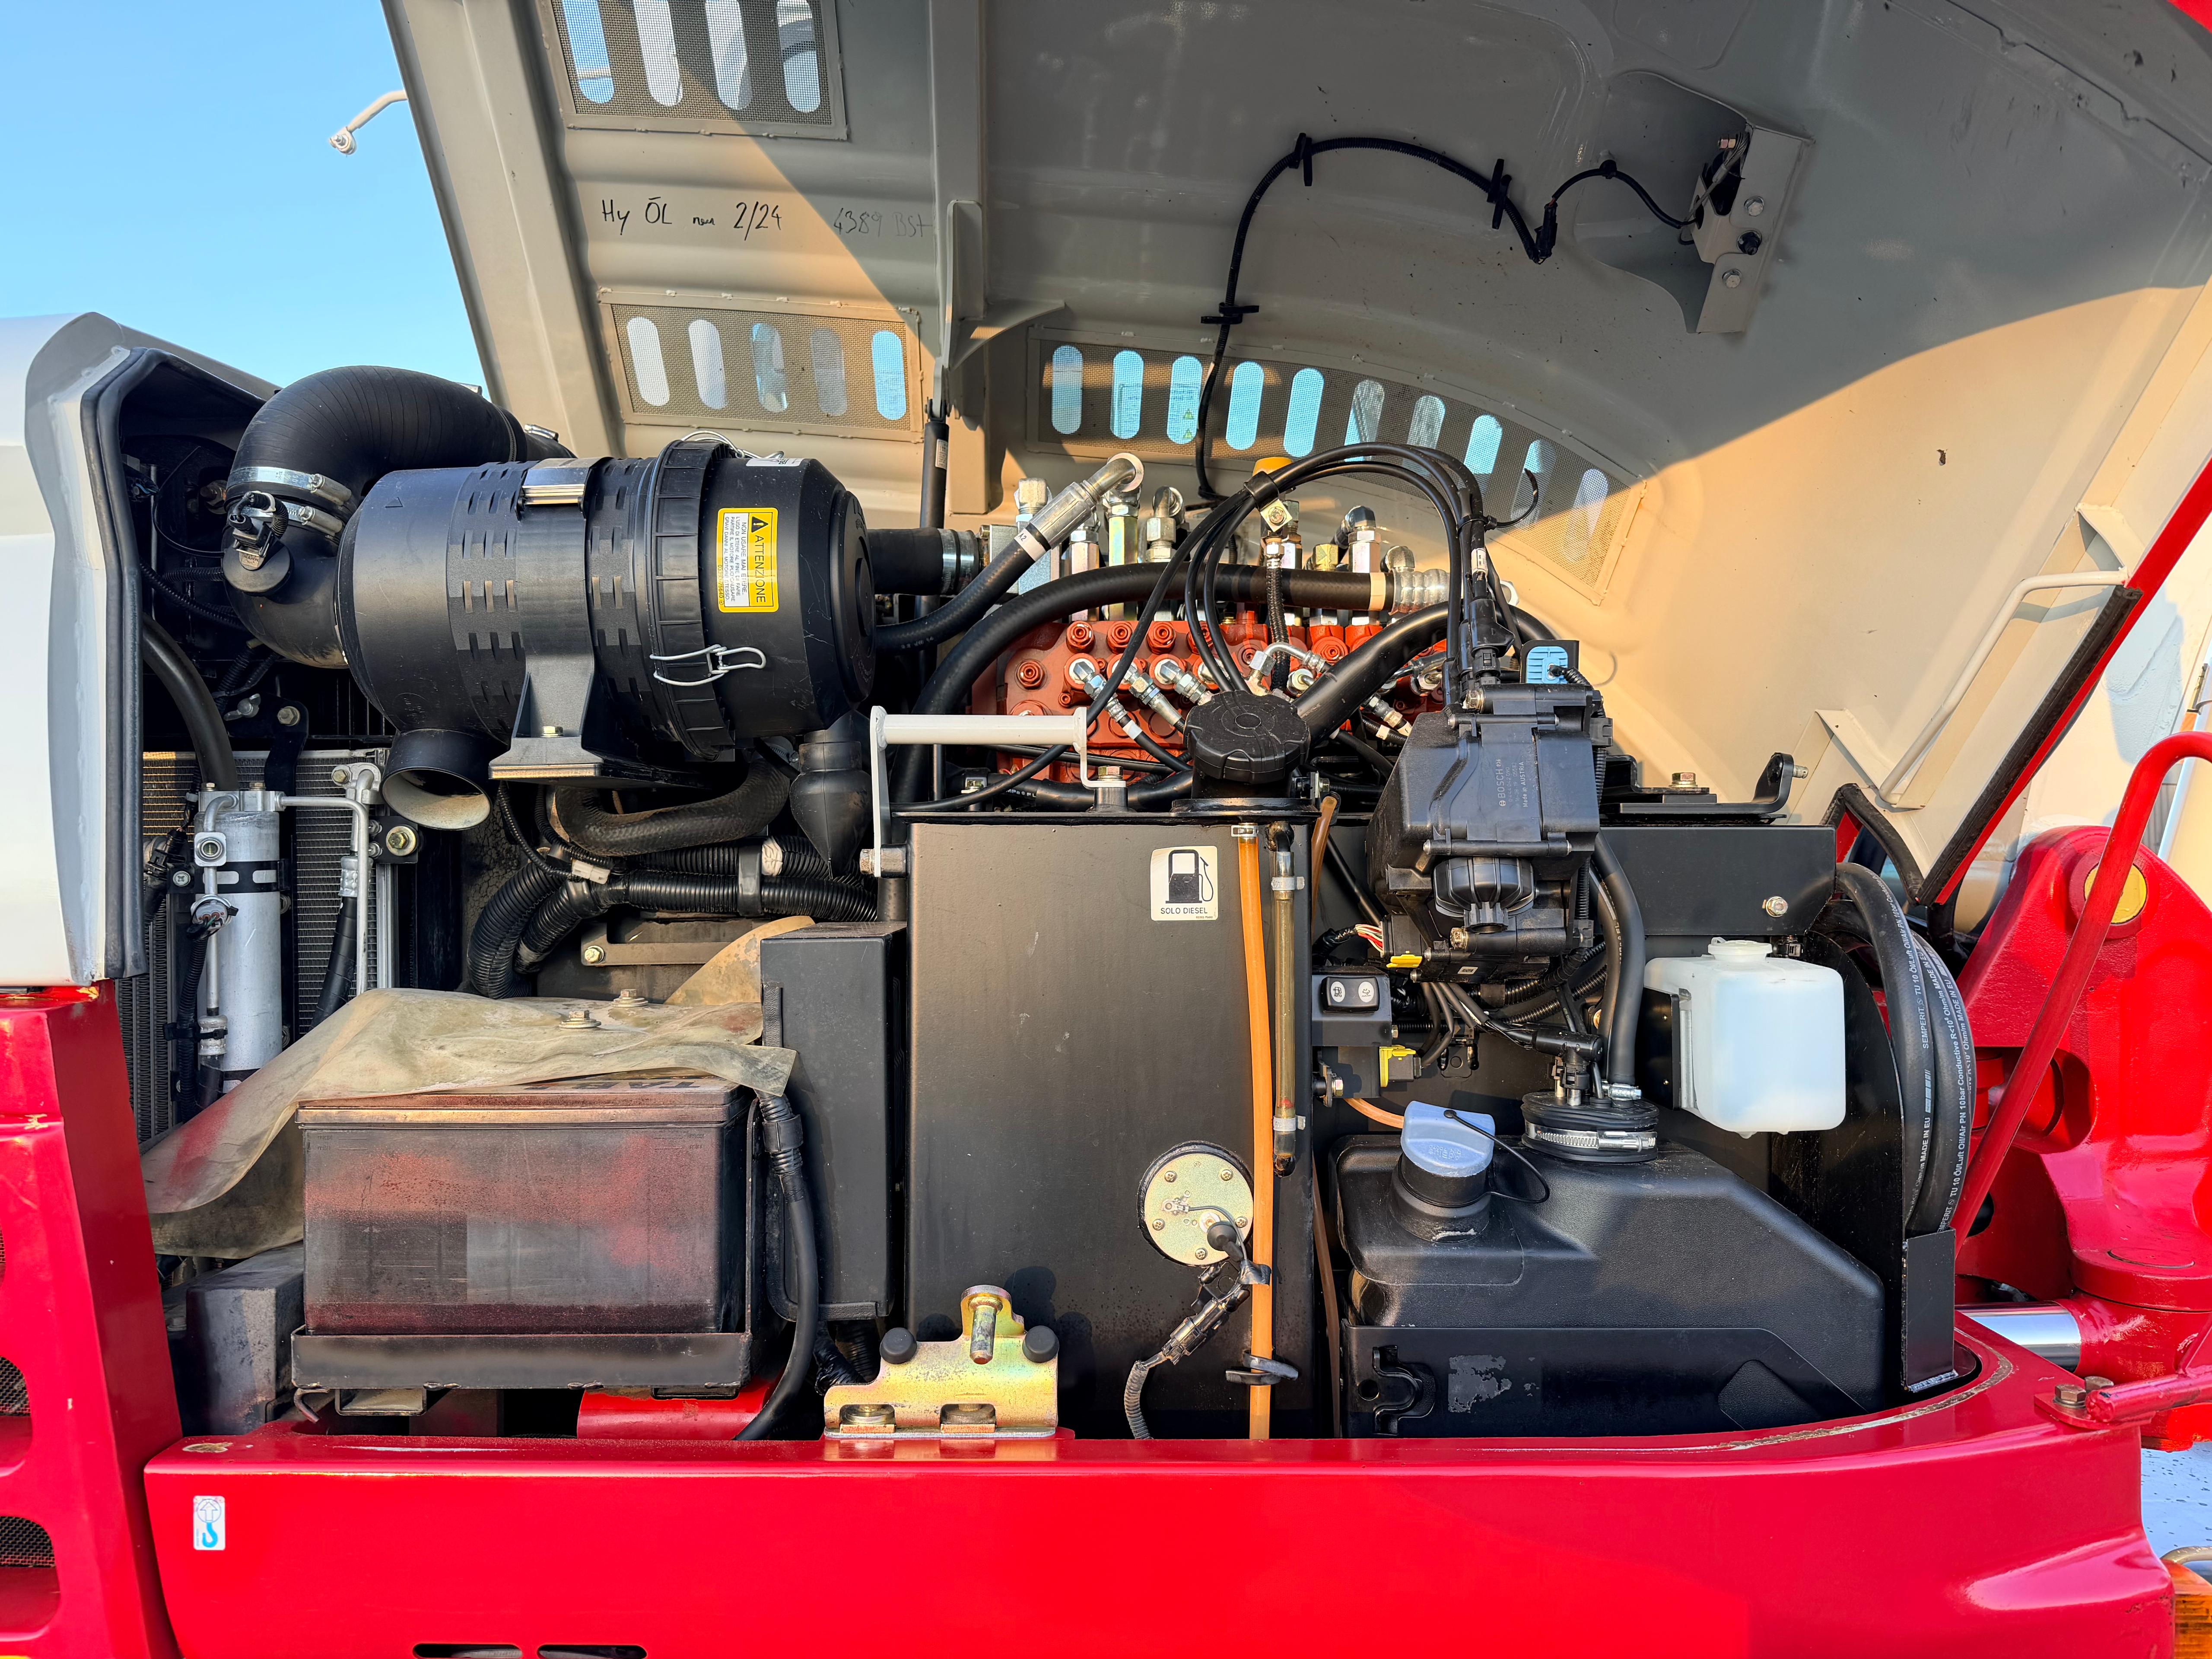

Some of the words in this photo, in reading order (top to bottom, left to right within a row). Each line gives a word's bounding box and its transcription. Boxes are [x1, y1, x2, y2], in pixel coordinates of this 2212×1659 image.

[602, 199, 630, 236] Hy
[734, 201, 782, 241] 2/24
[834, 207, 883, 237] 4389
[1018, 533, 1027, 541] A2
[755, 535, 766, 603] ATTENZIONE
[1496, 769, 1505, 798] BOSCH
[1891, 903, 1900, 918] 10bar
[1896, 919, 1904, 928] PN
[1919, 951, 1927, 960] EU
[1924, 960, 1931, 969] IN
[1913, 975, 1919, 983] 10
[1927, 970, 1942, 989] MADE
[1945, 980, 1954, 989] EU
[1939, 990, 1951, 1015] Ohm/m
[1952, 1000, 1964, 1021] MADE
[1919, 1007, 1929, 1049] SEMPERIT
[1961, 1023, 1970, 1050] Ohm/m
[1952, 1041, 1964, 1086] Conductive
[1924, 1117, 1931, 1128] EU
[1960, 1112, 1966, 1124] PN
[1924, 1130, 1930, 1138] IN
[1920, 1139, 1929, 1162] MADE
[1953, 1177, 1960, 1185] 10
[1950, 1187, 1957, 1197] TU
[1937, 1207, 1952, 1232] EMPERIT
